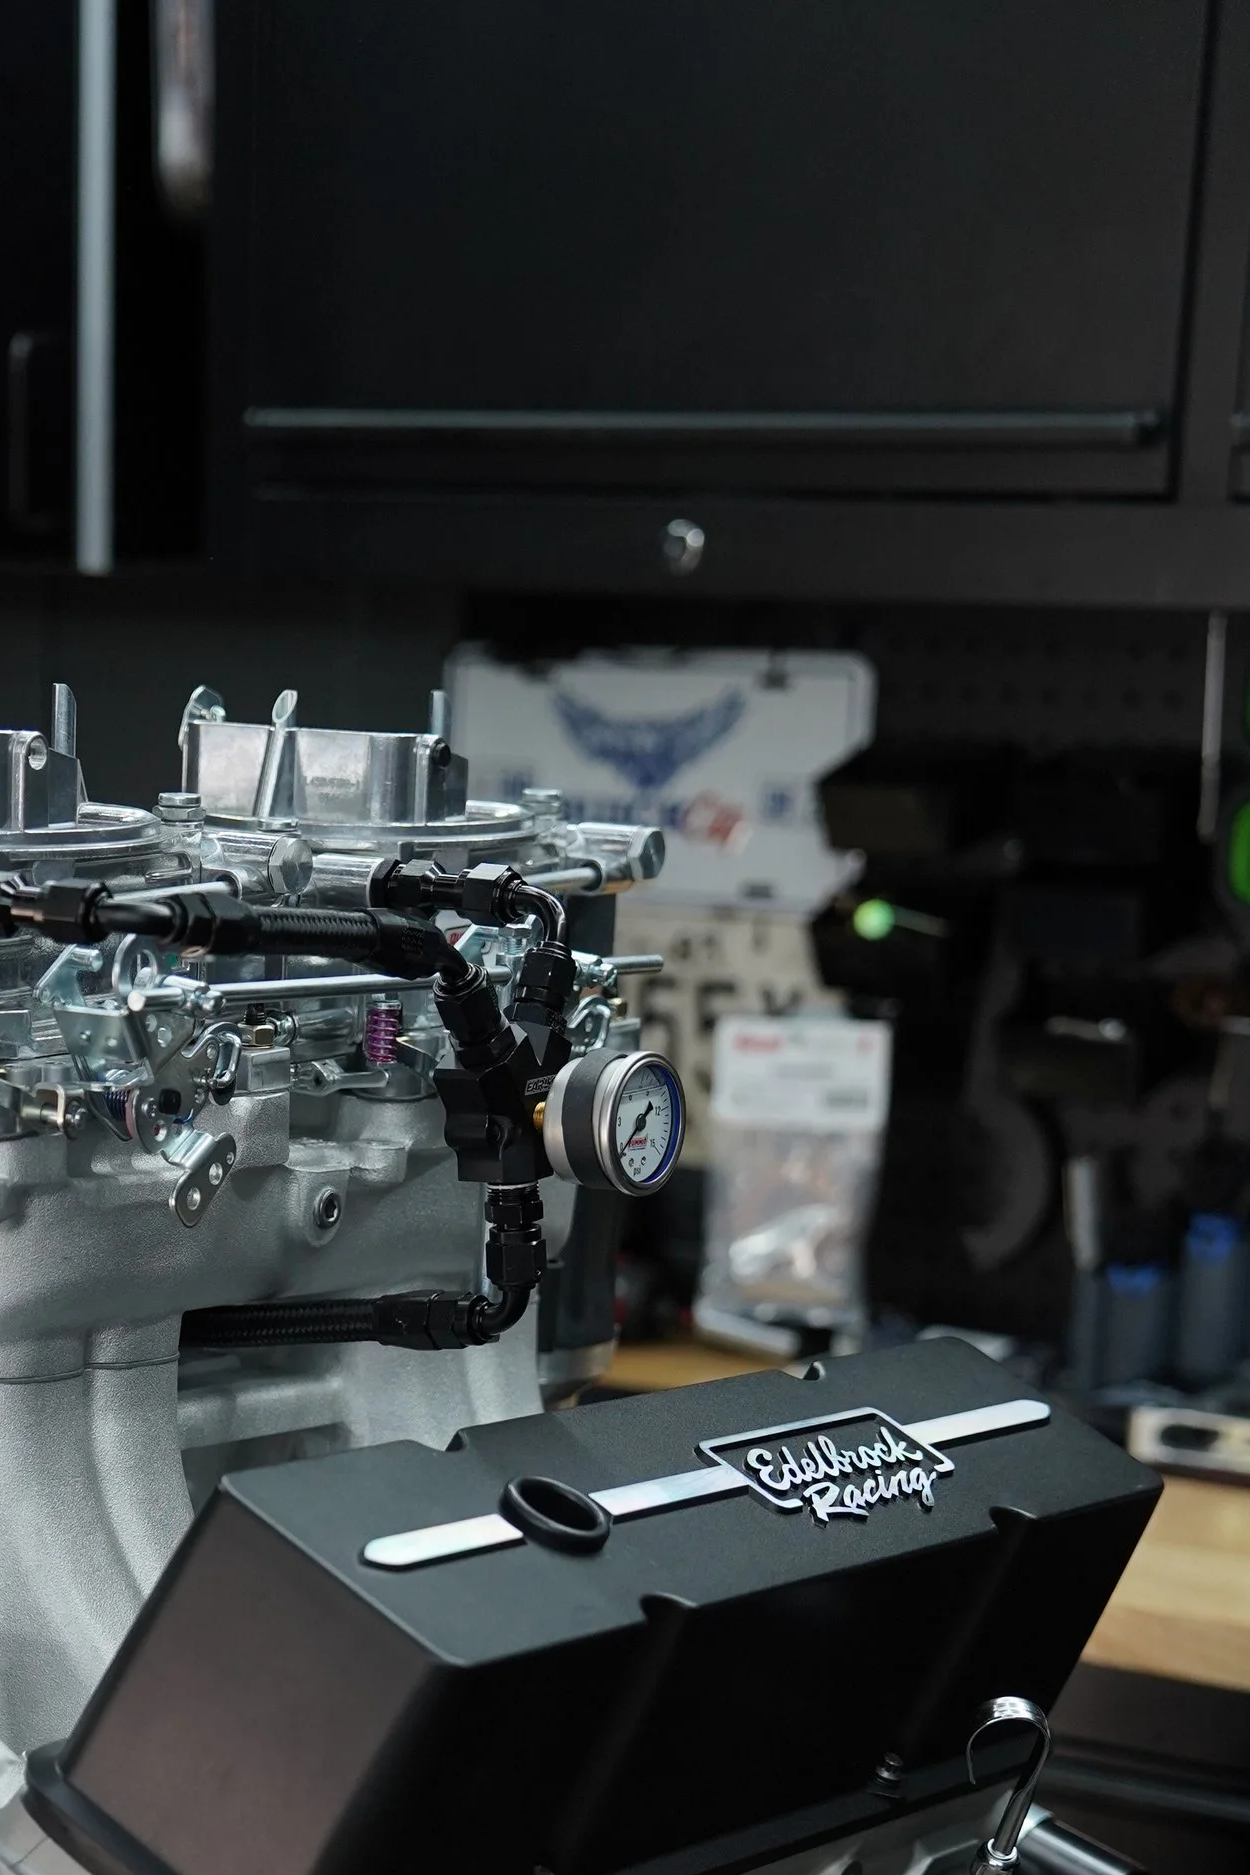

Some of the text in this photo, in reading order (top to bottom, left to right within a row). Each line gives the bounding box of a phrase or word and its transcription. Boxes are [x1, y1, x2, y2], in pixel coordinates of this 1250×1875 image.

[654, 1105, 662, 1116] 12
[633, 1165, 642, 1177] psi
[746, 1426, 924, 1491] Edelbrock
[803, 1466, 937, 1522] Racing
